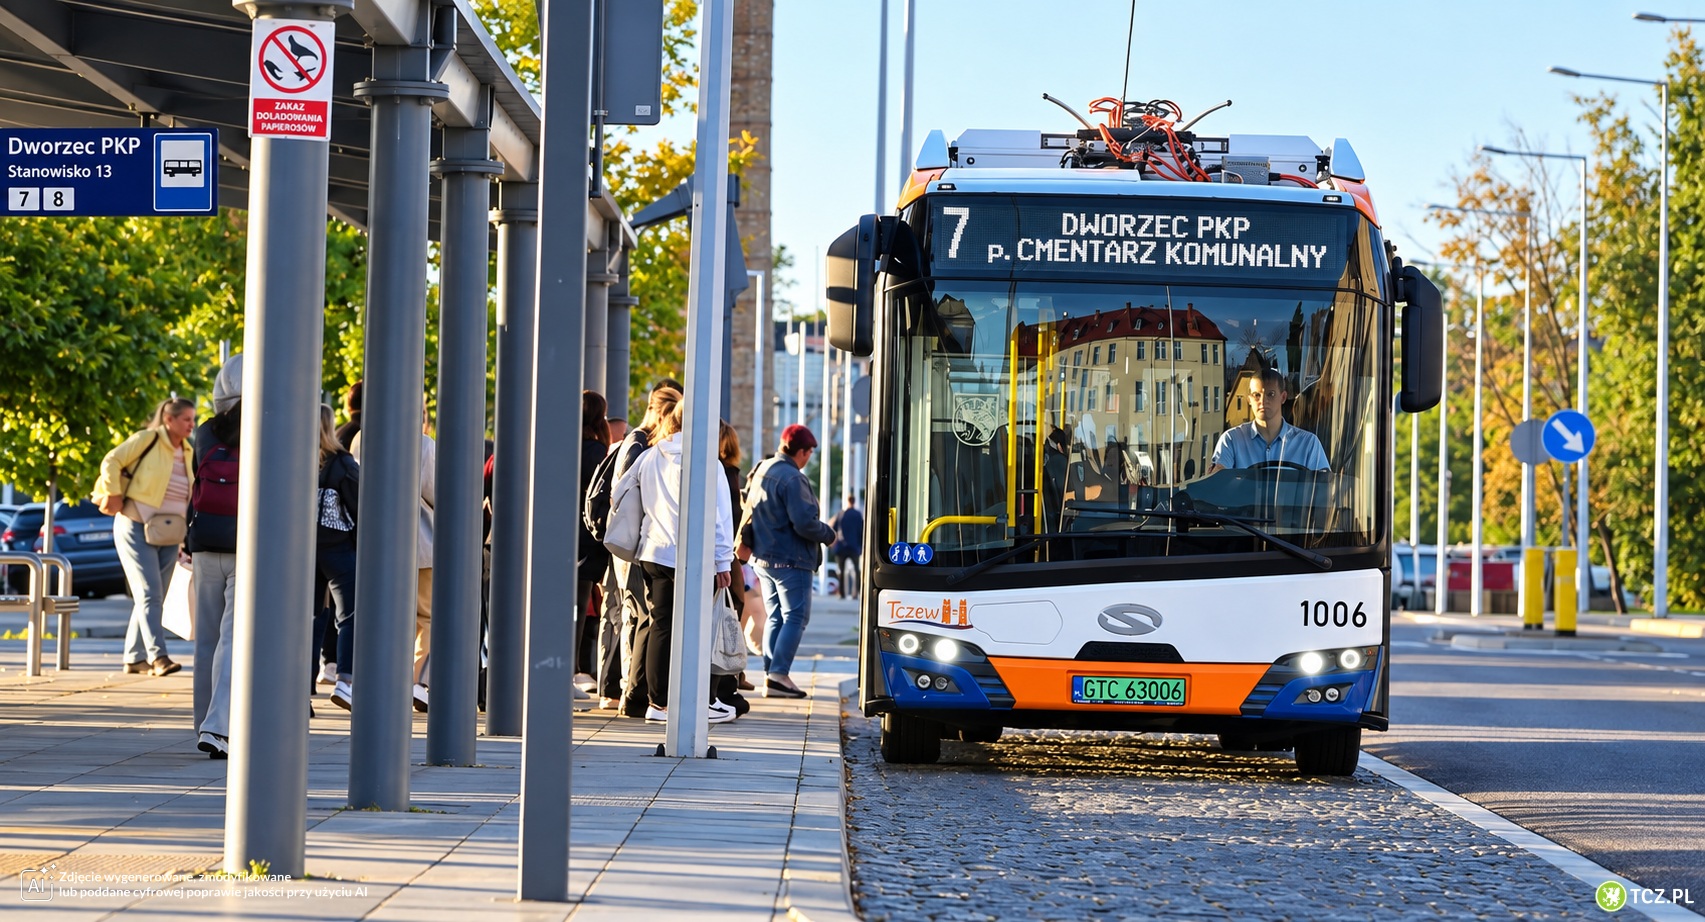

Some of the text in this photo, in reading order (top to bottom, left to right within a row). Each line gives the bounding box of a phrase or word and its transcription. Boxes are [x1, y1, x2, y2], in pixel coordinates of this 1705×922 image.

[274, 101, 305, 111] ZAKAZ
[8, 137, 141, 155] Dworzec PKP
[8, 164, 112, 178] Stanowisko 13
[19, 191, 64, 207] 7 8
[943, 206, 970, 259] 7
[1061, 212, 1250, 240] DWORZEC PKP
[1017, 238, 1157, 265] CMENTARZ
[1165, 241, 1327, 269] KOMUNALNY
[886, 601, 940, 619] Tczew
[1300, 600, 1367, 628] 1006
[1084, 679, 1182, 700] GTC 63006
